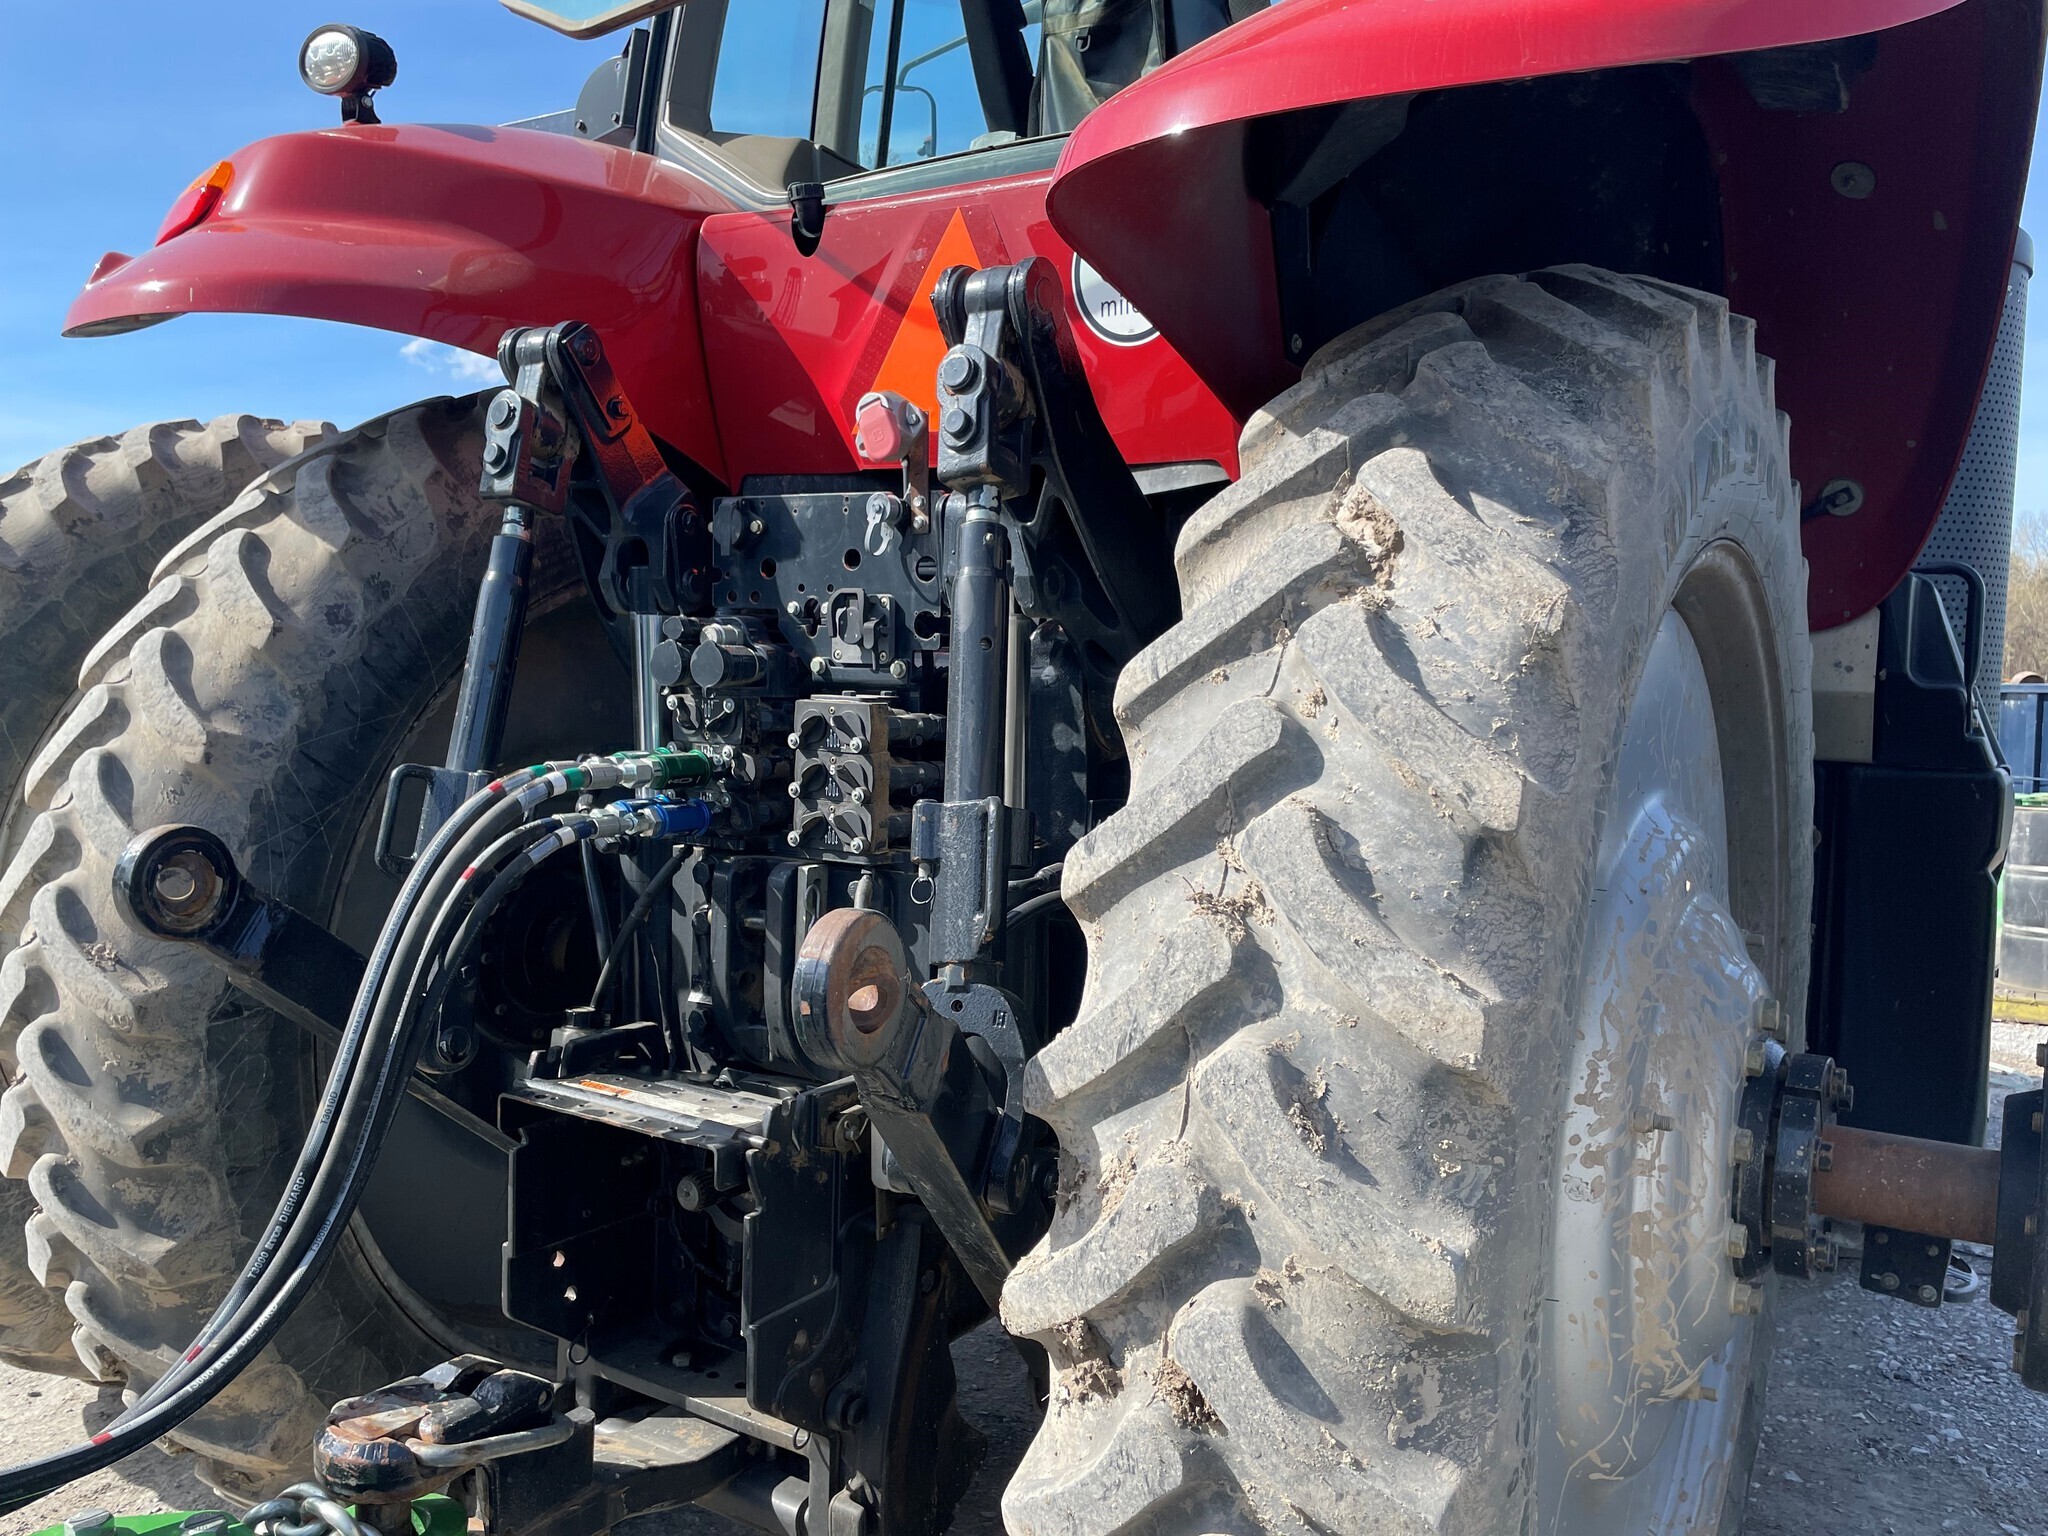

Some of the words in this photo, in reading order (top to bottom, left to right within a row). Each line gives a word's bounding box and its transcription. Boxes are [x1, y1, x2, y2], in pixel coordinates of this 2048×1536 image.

[829, 765, 836, 775] 5
[352, 1019, 361, 1035] MAX
[358, 1007, 364, 1018] WP
[366, 979, 375, 995] BAR
[373, 959, 382, 976] 3100
[379, 948, 387, 960] PSI
[405, 883, 415, 900] FRAS
[417, 848, 436, 877] ABRASION
[436, 820, 457, 848] RESISTANT
[320, 1091, 338, 1126] T3010D
[248, 1249, 269, 1280] T3000
[279, 1175, 306, 1223] DIEHARD
[310, 1218, 331, 1254] T3008D
[185, 1367, 215, 1393] T3000
